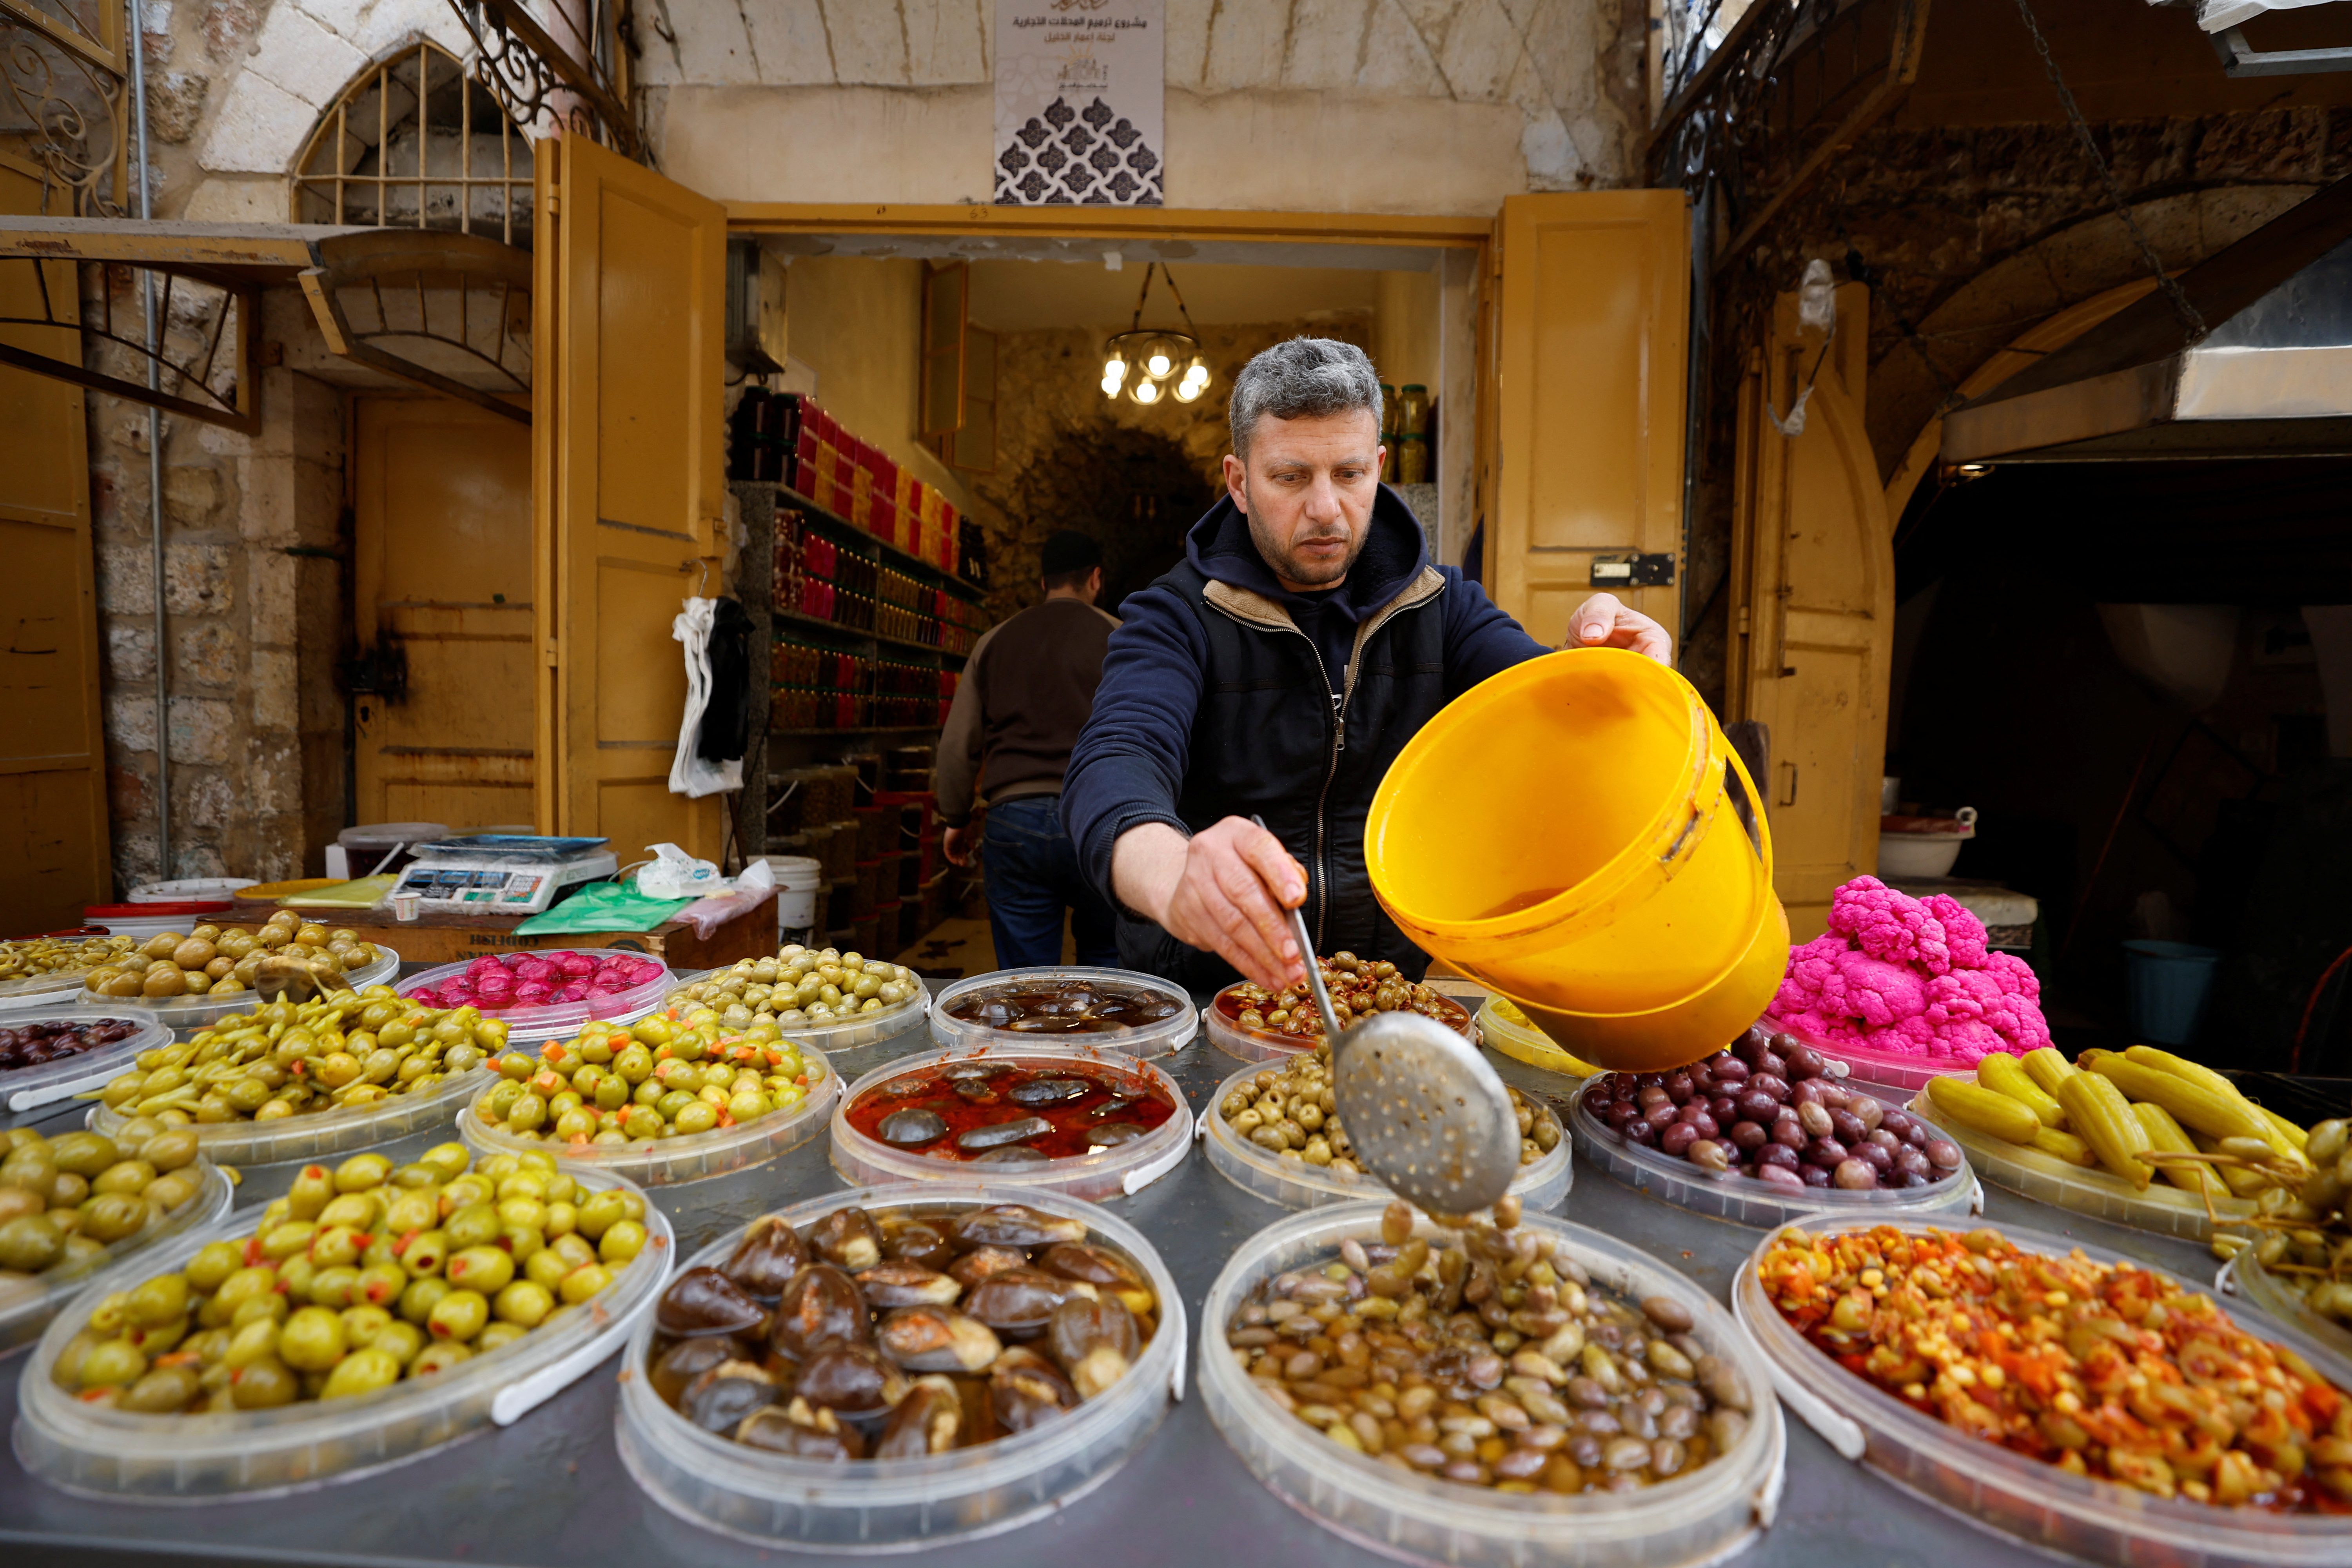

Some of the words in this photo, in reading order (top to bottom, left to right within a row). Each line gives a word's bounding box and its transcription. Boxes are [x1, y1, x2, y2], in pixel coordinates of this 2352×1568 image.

[1013, 16, 1046, 27] التجارية
[1048, 16, 1085, 25] المحلات
[1087, 16, 1112, 29] ترميم
[1114, 16, 1147, 29] مشروع
[470, 934, 539, 947] CODFISH
